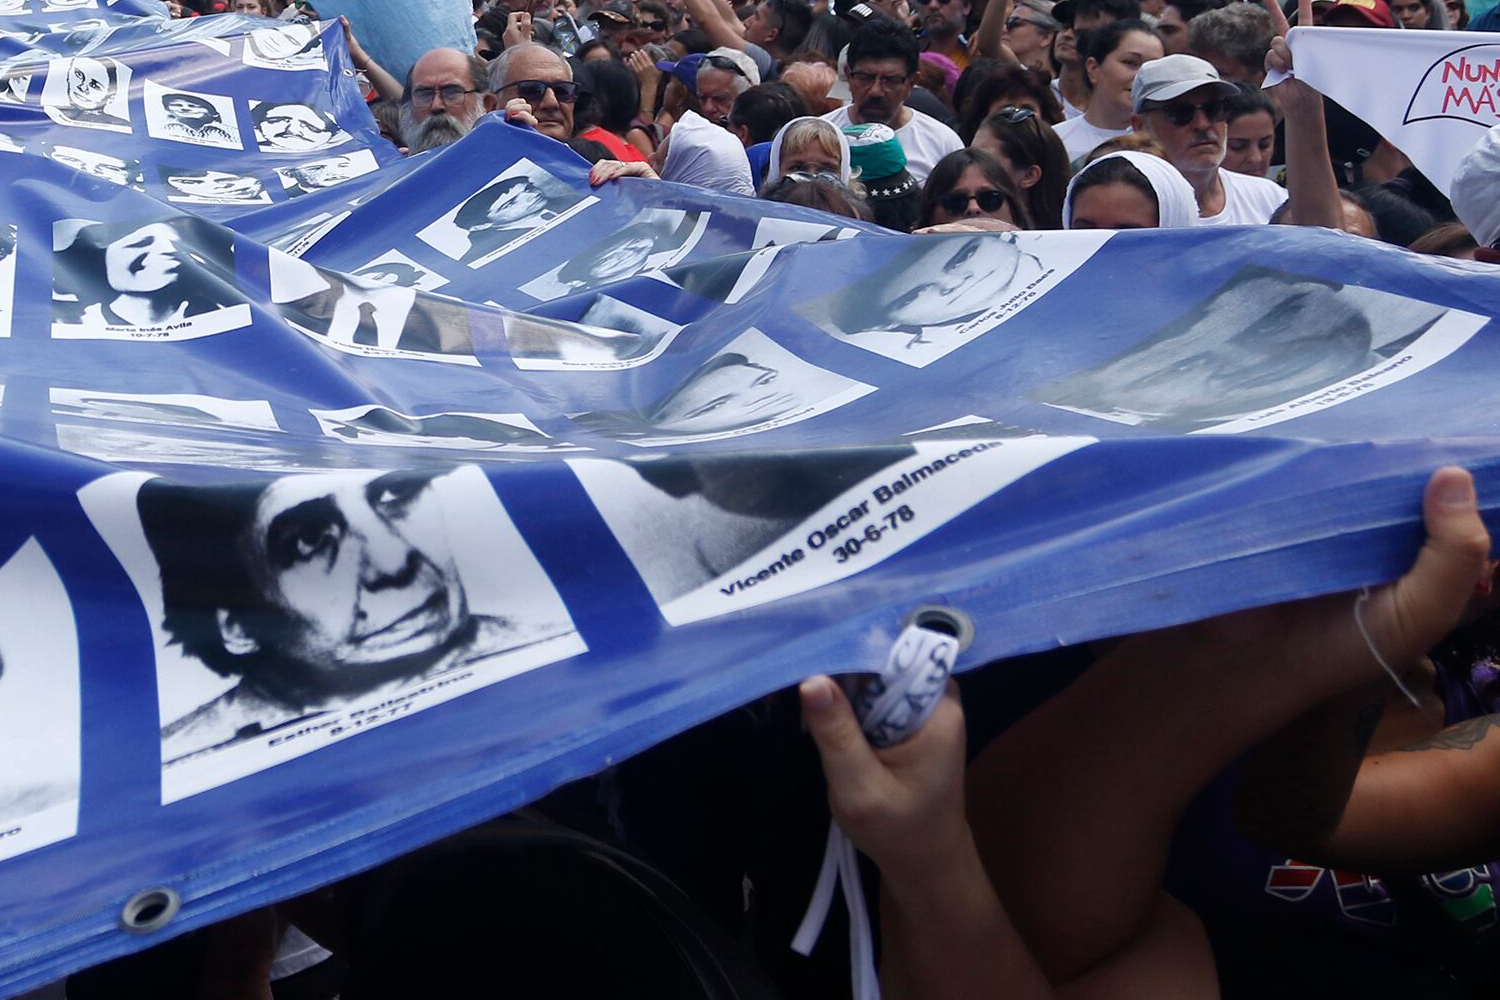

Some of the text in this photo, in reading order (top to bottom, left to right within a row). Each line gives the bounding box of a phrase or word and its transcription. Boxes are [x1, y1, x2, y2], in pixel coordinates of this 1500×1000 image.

[165, 320, 193, 331] Avila
[719, 440, 1004, 596] Vicente Oscar Balmaceda
[832, 504, 916, 564] 30-6-78
